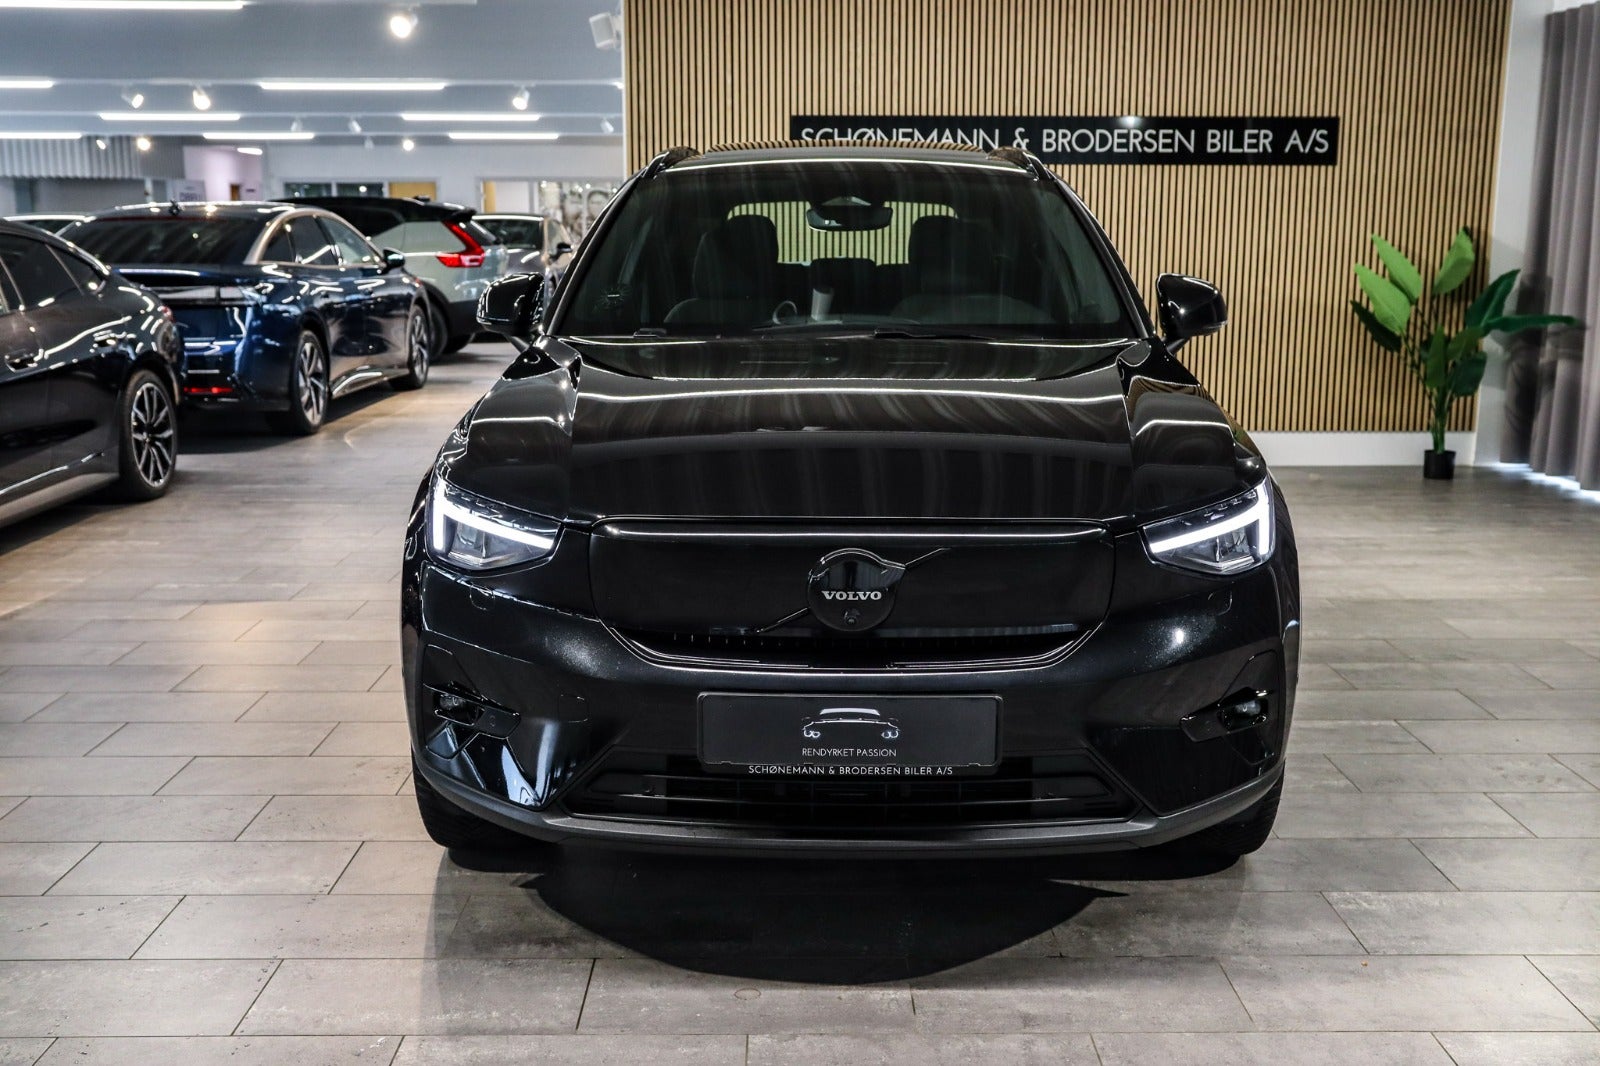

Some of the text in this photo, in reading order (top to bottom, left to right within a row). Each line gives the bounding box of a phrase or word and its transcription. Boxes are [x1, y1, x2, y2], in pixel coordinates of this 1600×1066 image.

[1012, 127, 1030, 150] &
[1042, 128, 1195, 153] BRODERSEN
[1206, 128, 1273, 153] BILER
[1284, 128, 1329, 154] A/S
[821, 590, 882, 601] VOLVO
[802, 747, 897, 757] RENDYRKET PASSION
[748, 765, 953, 775] SCHØNEMANN & BRODERSEN BILER A/S
